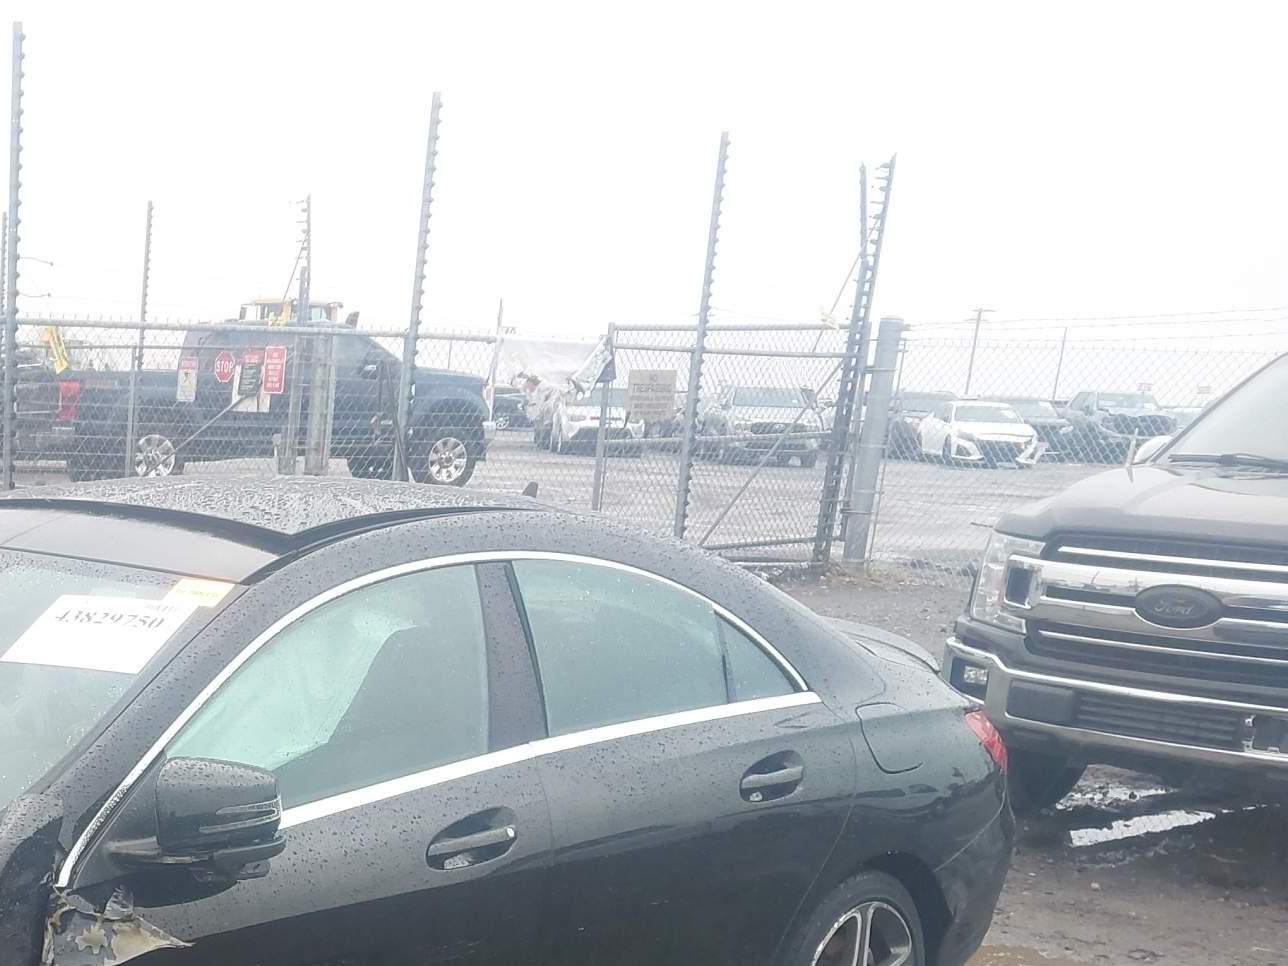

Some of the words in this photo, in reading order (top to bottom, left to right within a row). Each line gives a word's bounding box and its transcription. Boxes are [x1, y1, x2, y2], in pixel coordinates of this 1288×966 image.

[216, 361, 233, 373] STOP
[1152, 599, 1196, 617] Ford
[54, 608, 166, 629] 43829750
